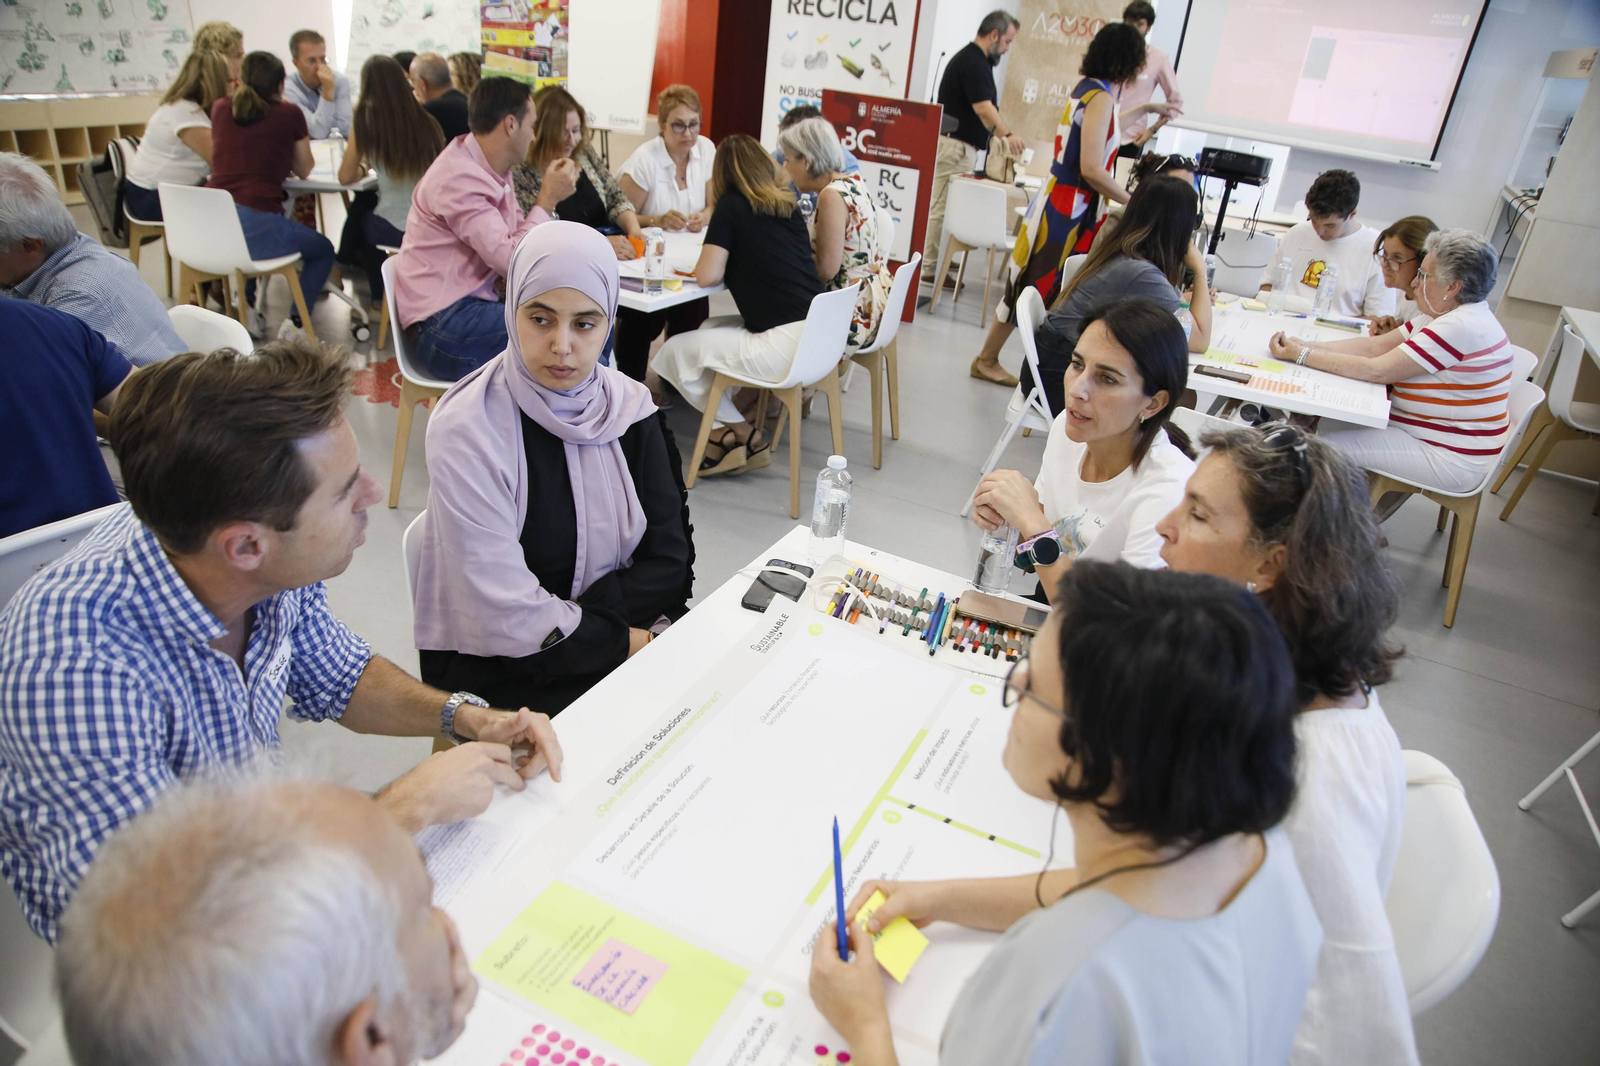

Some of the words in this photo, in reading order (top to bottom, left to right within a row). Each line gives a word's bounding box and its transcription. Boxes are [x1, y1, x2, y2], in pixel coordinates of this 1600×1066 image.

[787, 0, 898, 26] RECICLA
[779, 84, 795, 95] NO
[871, 104, 902, 116] ALMERÍA
[614, 759, 655, 796] soluciones
[653, 727, 688, 759] queremos
[686, 691, 722, 727] encontrar?
[645, 741, 657, 751] de
[653, 707, 691, 741] Soluciones
[596, 830, 630, 863] Desarrollo
[635, 802, 658, 823] Detalle
[656, 794, 666, 802] de
